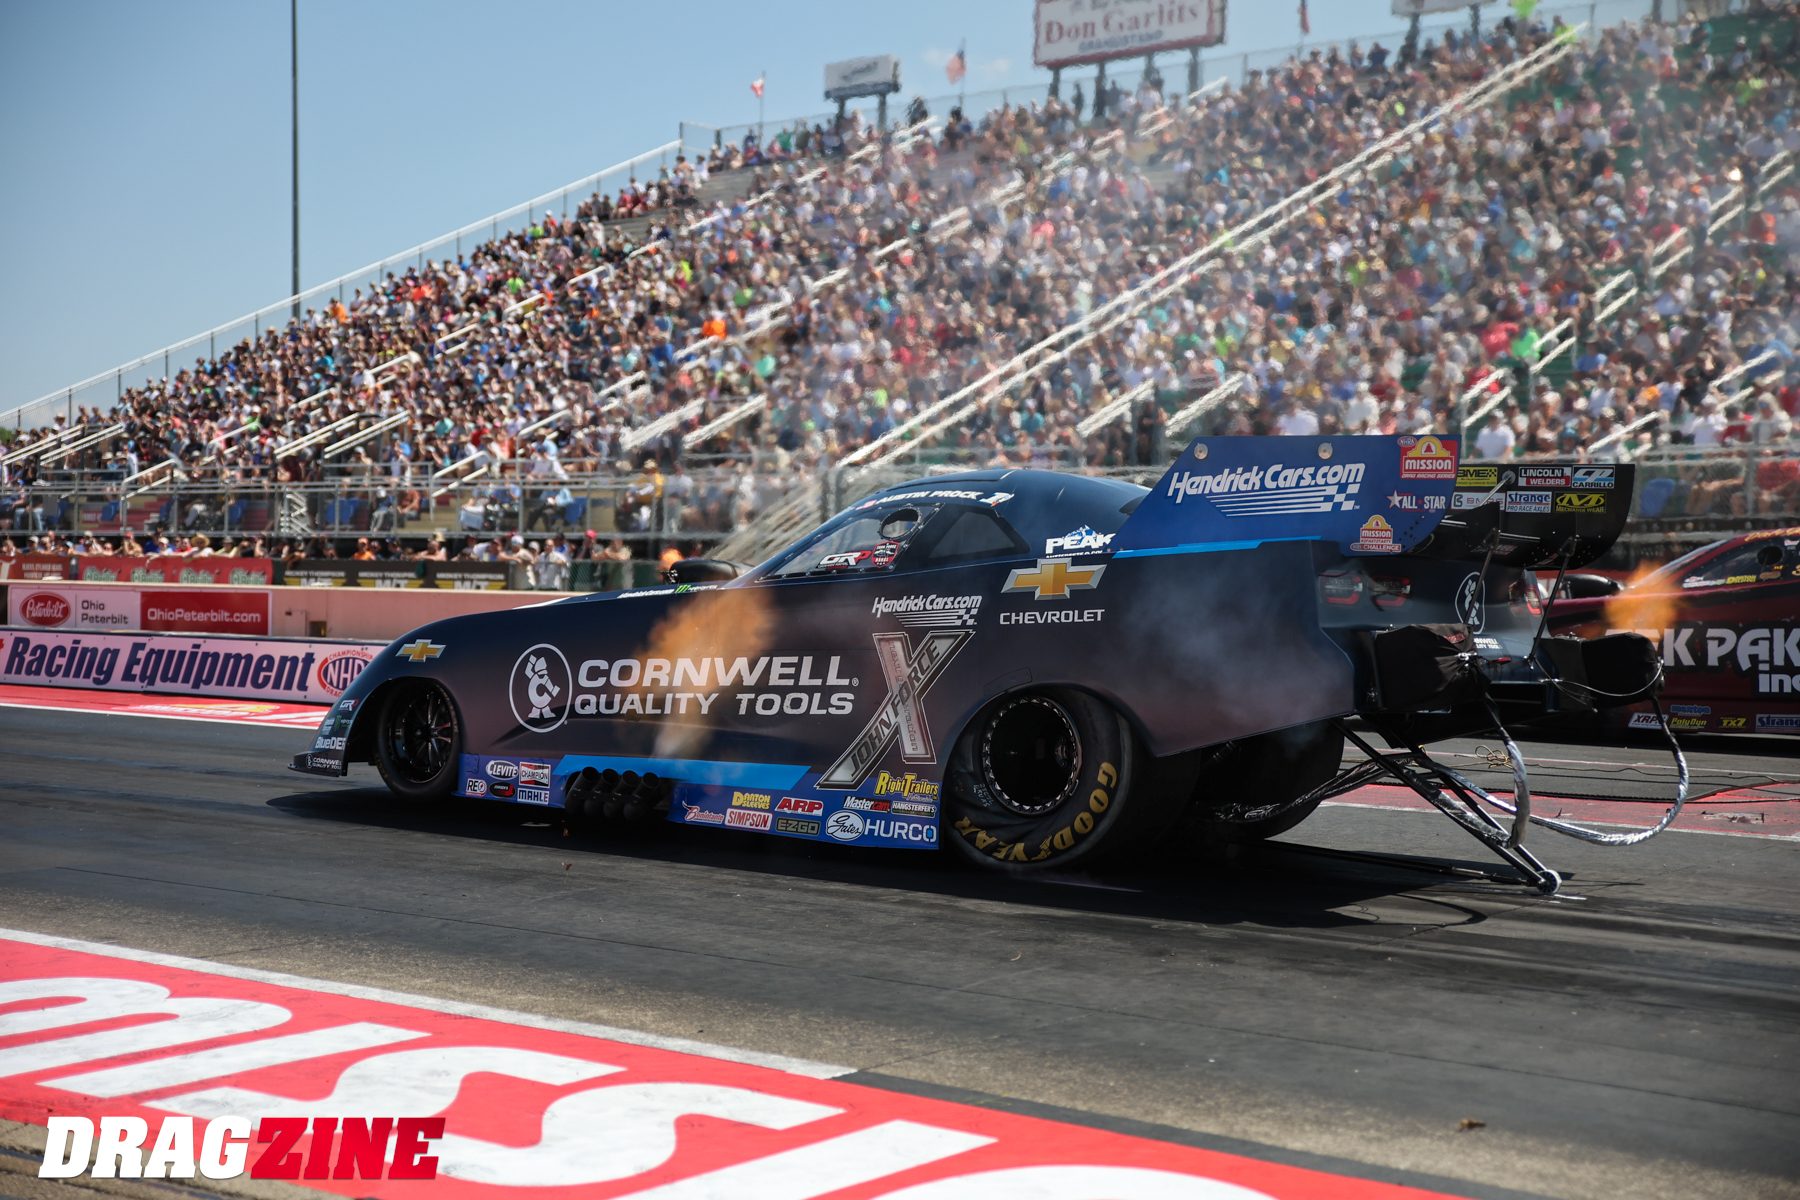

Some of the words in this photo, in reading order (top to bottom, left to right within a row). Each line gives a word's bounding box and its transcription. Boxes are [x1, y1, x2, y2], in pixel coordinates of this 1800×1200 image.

[1045, 20, 1096, 44] Don
[1102, 2, 1198, 32] Garlits
[1405, 459, 1452, 470] MISSION
[1521, 469, 1562, 477] LINCOLN
[875, 491, 931, 504] AUSTIN
[929, 490, 984, 500] PROCK
[1402, 496, 1418, 509] ALL
[1424, 496, 1446, 509] STAR
[1508, 492, 1551, 503] Strange
[1362, 530, 1391, 538] MISSION
[1045, 533, 1116, 554] PEAK
[81, 600, 105, 611] Ohio
[81, 613, 128, 625] Peterbilt
[147, 608, 261, 623] OhioPeterbilt.com
[1000, 609, 1105, 625] CHEVROLET
[4, 636, 120, 685] Racing
[121, 641, 315, 692] Equipment
[577, 656, 851, 688] CORNWELL
[574, 693, 720, 716] QUALITY
[736, 692, 855, 715] TOOLS
[486, 760, 519, 777] CLEVITE
[521, 769, 548, 780] CHAMPION
[519, 789, 549, 803] MAHLE
[843, 796, 890, 811] Mastercam
[742, 800, 770, 810] SLEEVES
[777, 798, 823, 813] ARP
[727, 810, 770, 828] SIMPSON
[864, 819, 937, 842] HURCO
